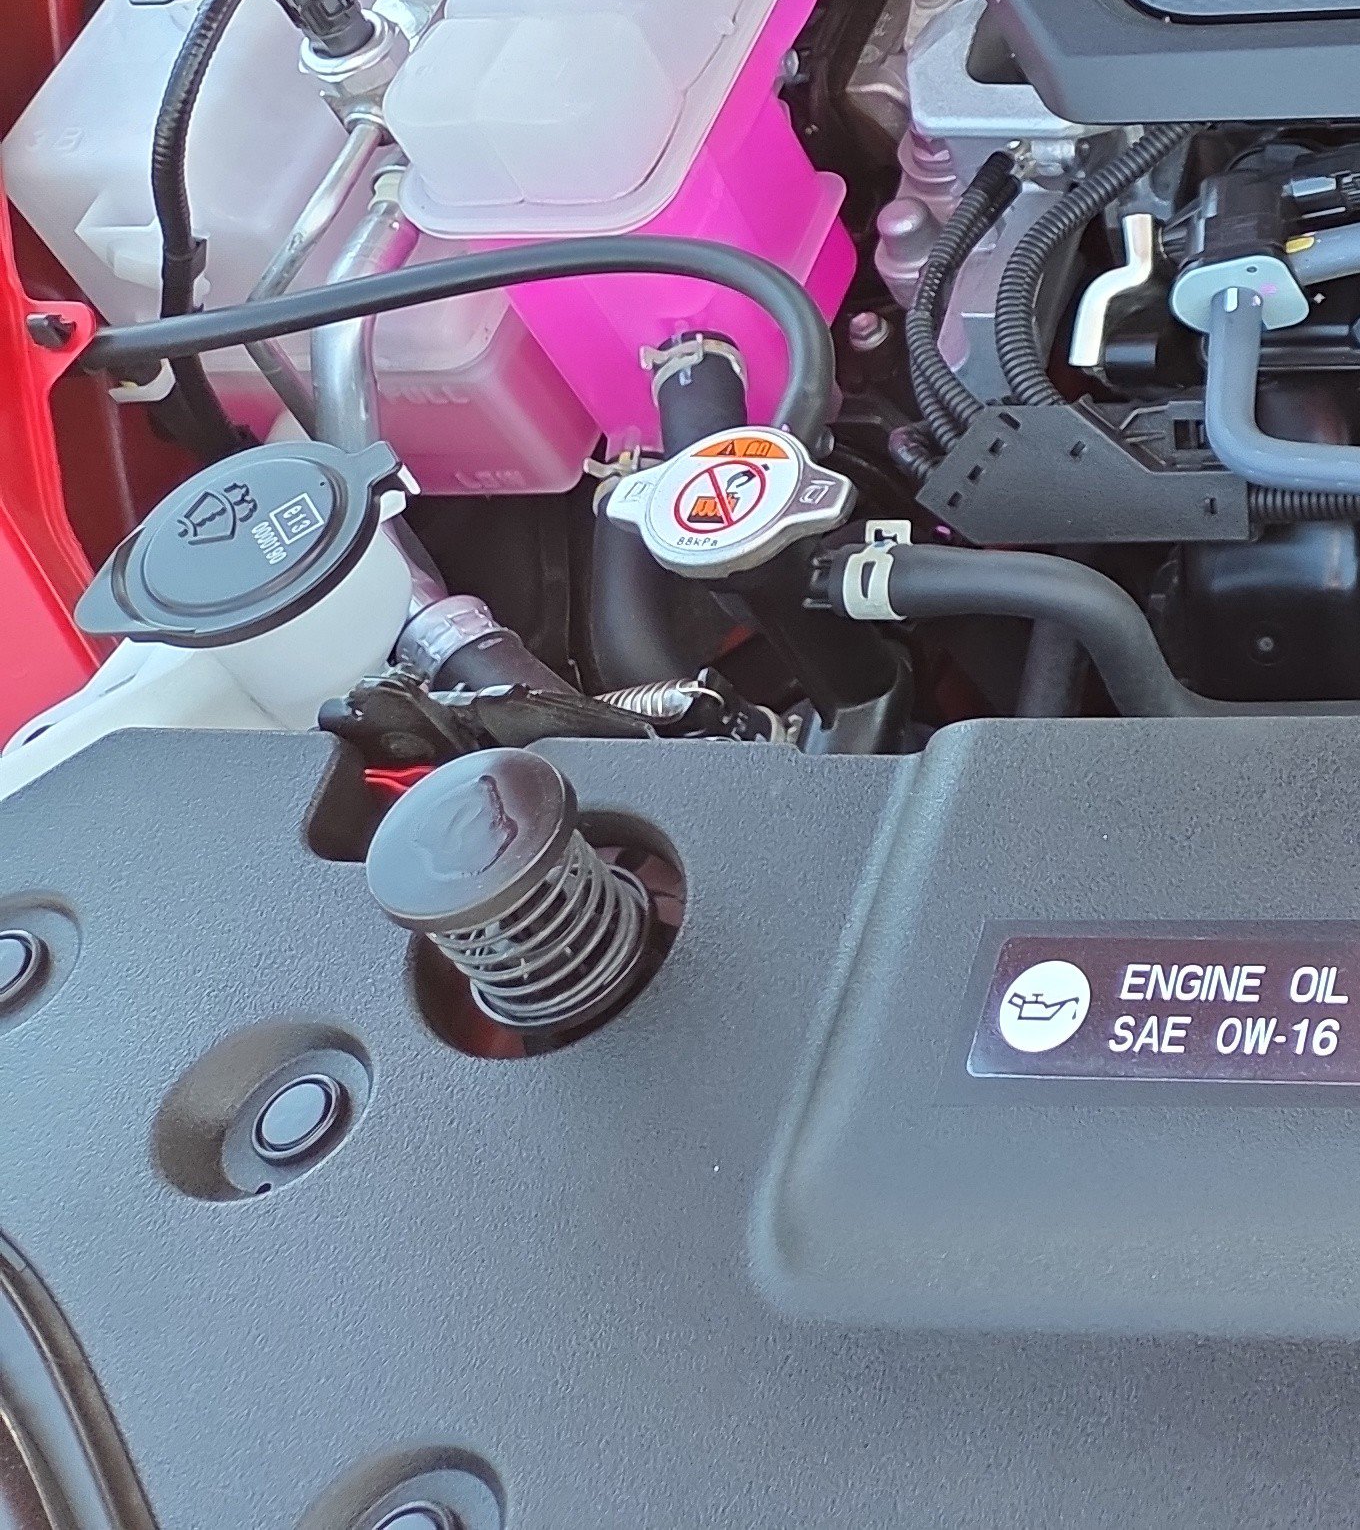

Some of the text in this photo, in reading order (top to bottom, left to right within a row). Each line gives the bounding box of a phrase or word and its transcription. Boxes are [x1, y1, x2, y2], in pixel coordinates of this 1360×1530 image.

[282, 504, 312, 534] e13
[250, 520, 288, 566] 0000190
[676, 536, 719, 547] 88kPa
[1119, 963, 1349, 1004] ENGINE OIL
[1108, 1015, 1341, 1057] SAE 0W-16
